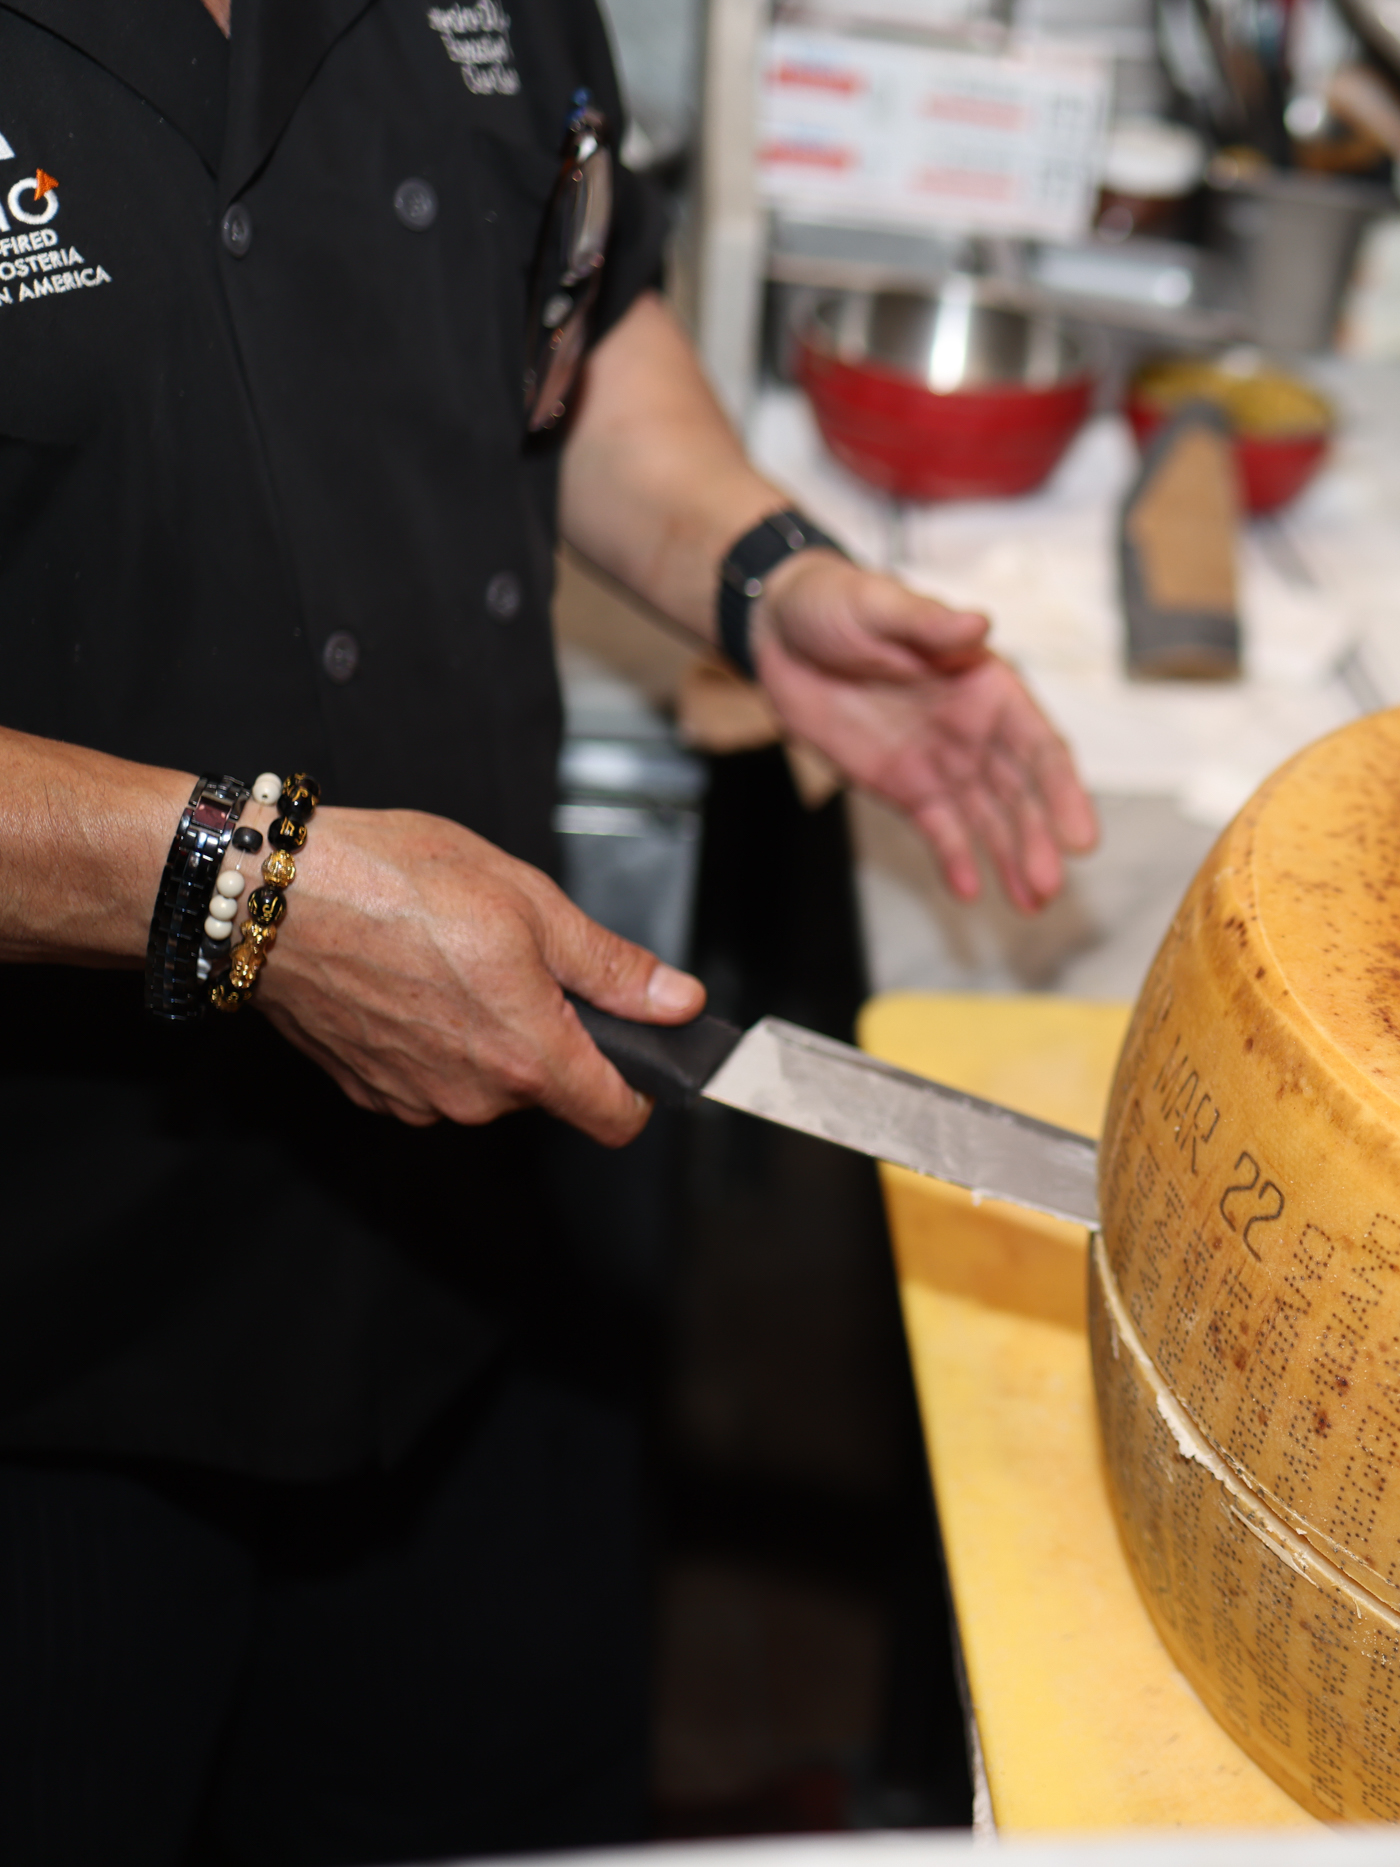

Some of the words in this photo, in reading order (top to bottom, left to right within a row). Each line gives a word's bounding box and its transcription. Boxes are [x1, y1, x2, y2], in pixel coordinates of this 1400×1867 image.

[19, 265, 112, 302] AMERICA
[1153, 1033, 1221, 1175] MAR
[1219, 1151, 1284, 1263] 22
